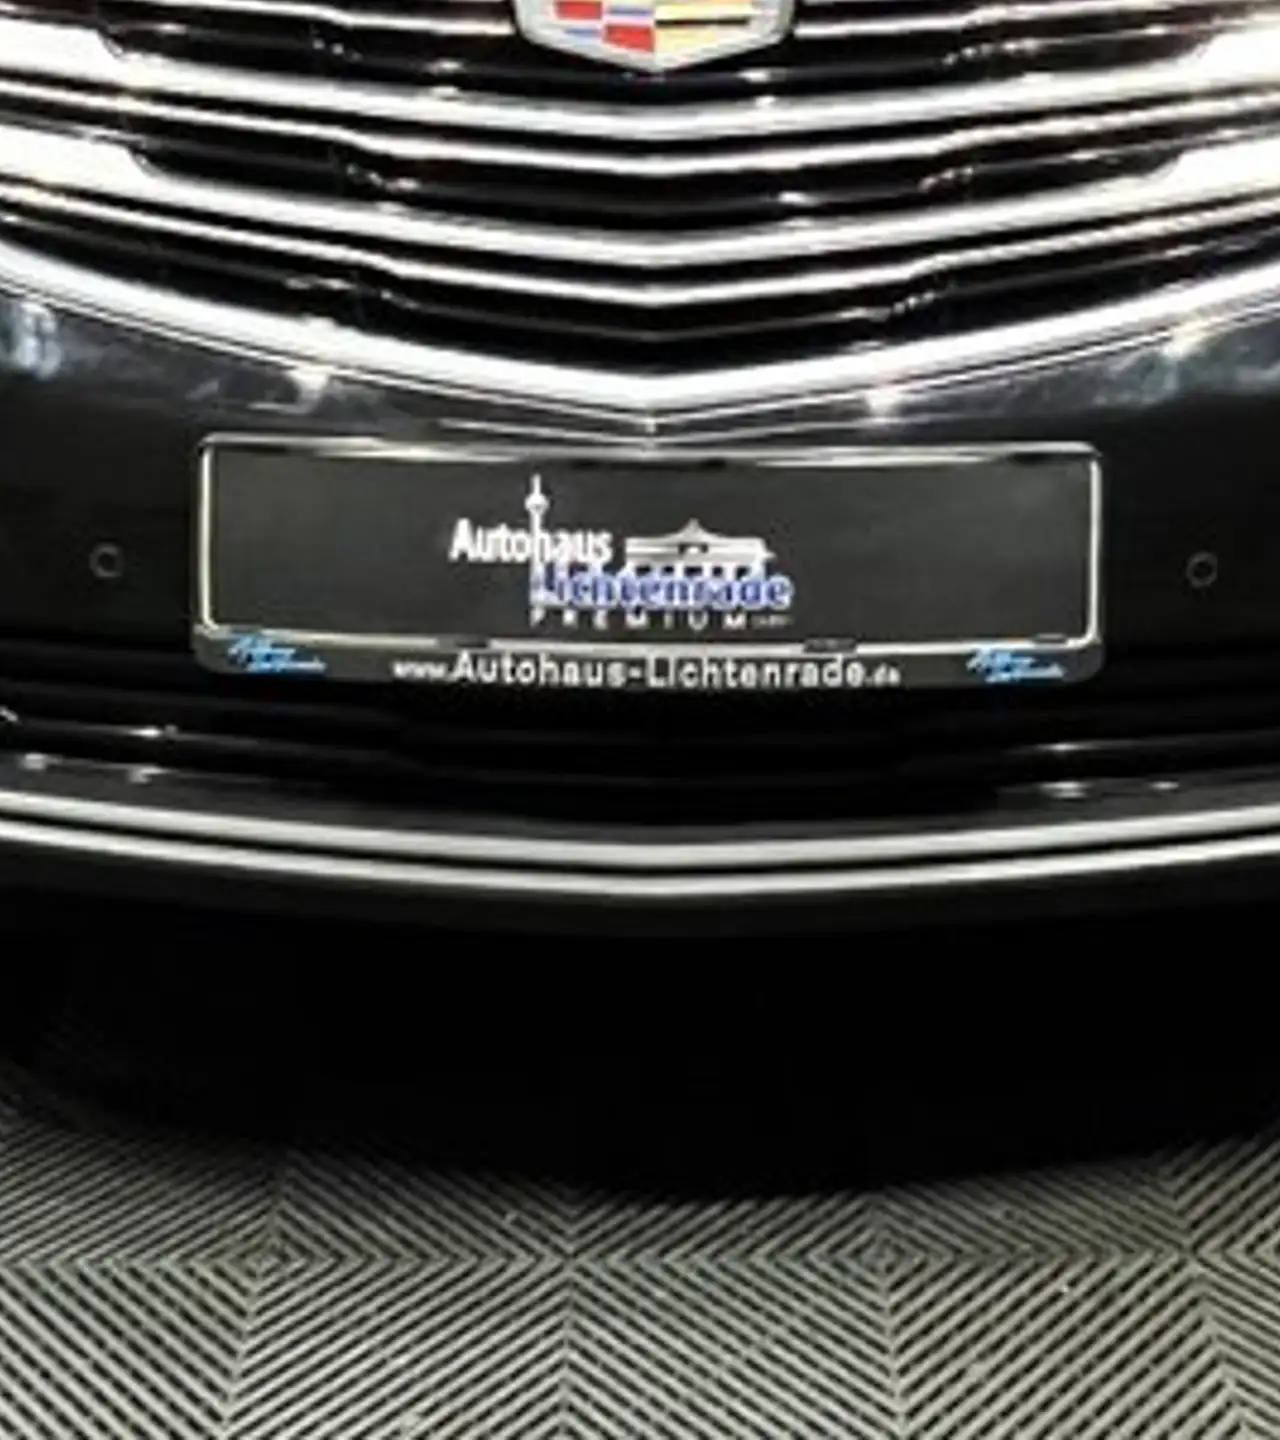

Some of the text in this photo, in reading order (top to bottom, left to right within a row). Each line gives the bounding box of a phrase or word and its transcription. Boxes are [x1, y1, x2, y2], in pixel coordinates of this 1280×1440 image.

[449, 518, 613, 562] Autohaus
[532, 562, 794, 609] Lichtenrade
[393, 650, 903, 689] www.Autohaus-Lichtenrade.de
